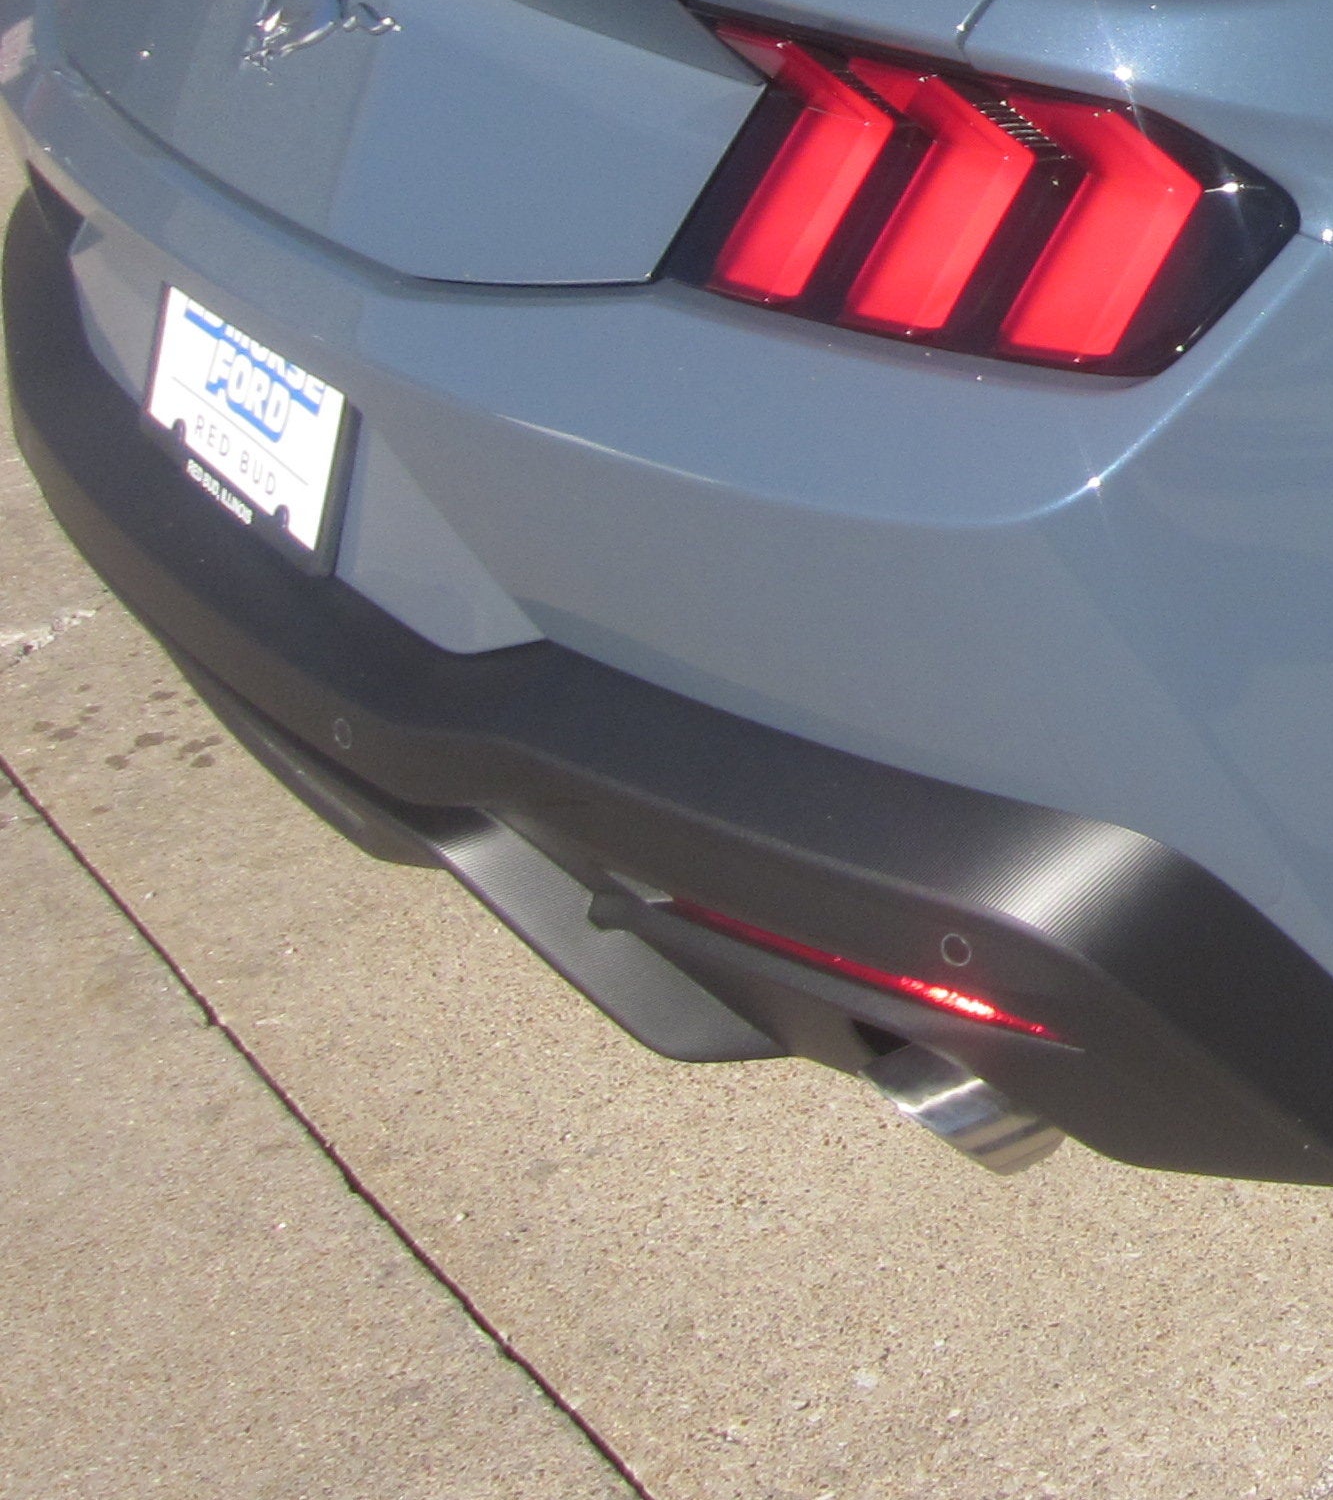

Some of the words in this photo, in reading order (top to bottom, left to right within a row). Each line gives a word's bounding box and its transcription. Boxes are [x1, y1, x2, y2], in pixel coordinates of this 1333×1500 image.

[204, 337, 293, 444] FORD
[195, 414, 231, 458] RED
[240, 448, 277, 496] BUD
